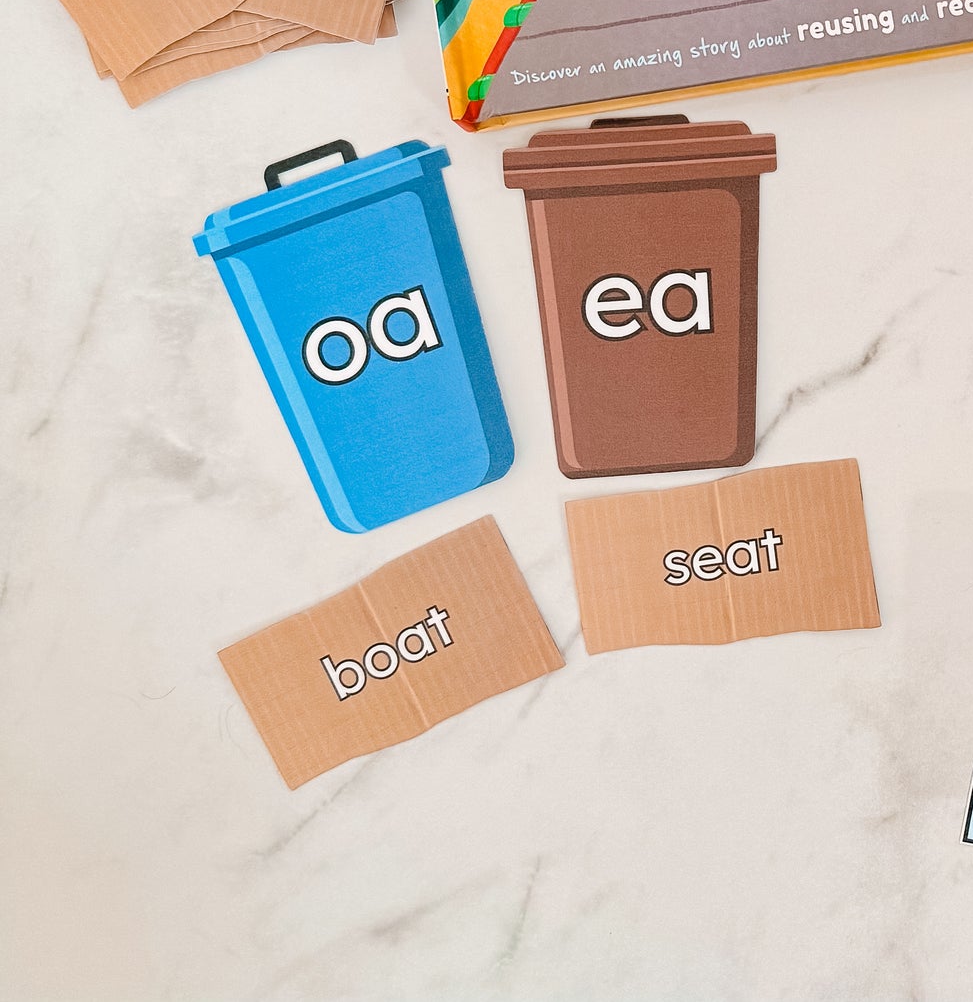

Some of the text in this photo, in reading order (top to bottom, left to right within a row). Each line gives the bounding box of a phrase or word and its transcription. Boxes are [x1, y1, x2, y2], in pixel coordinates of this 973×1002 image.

[510, 65, 581, 85] Discover
[589, 61, 606, 75] an
[613, 48, 683, 71] amazing
[690, 36, 741, 59] story
[748, 27, 791, 50] about
[797, 8, 894, 41] reusing
[901, 5, 929, 25] and
[302, 285, 443, 385] oa
[581, 267, 715, 341] ea
[663, 528, 783, 586] seat
[319, 605, 454, 701] boat
